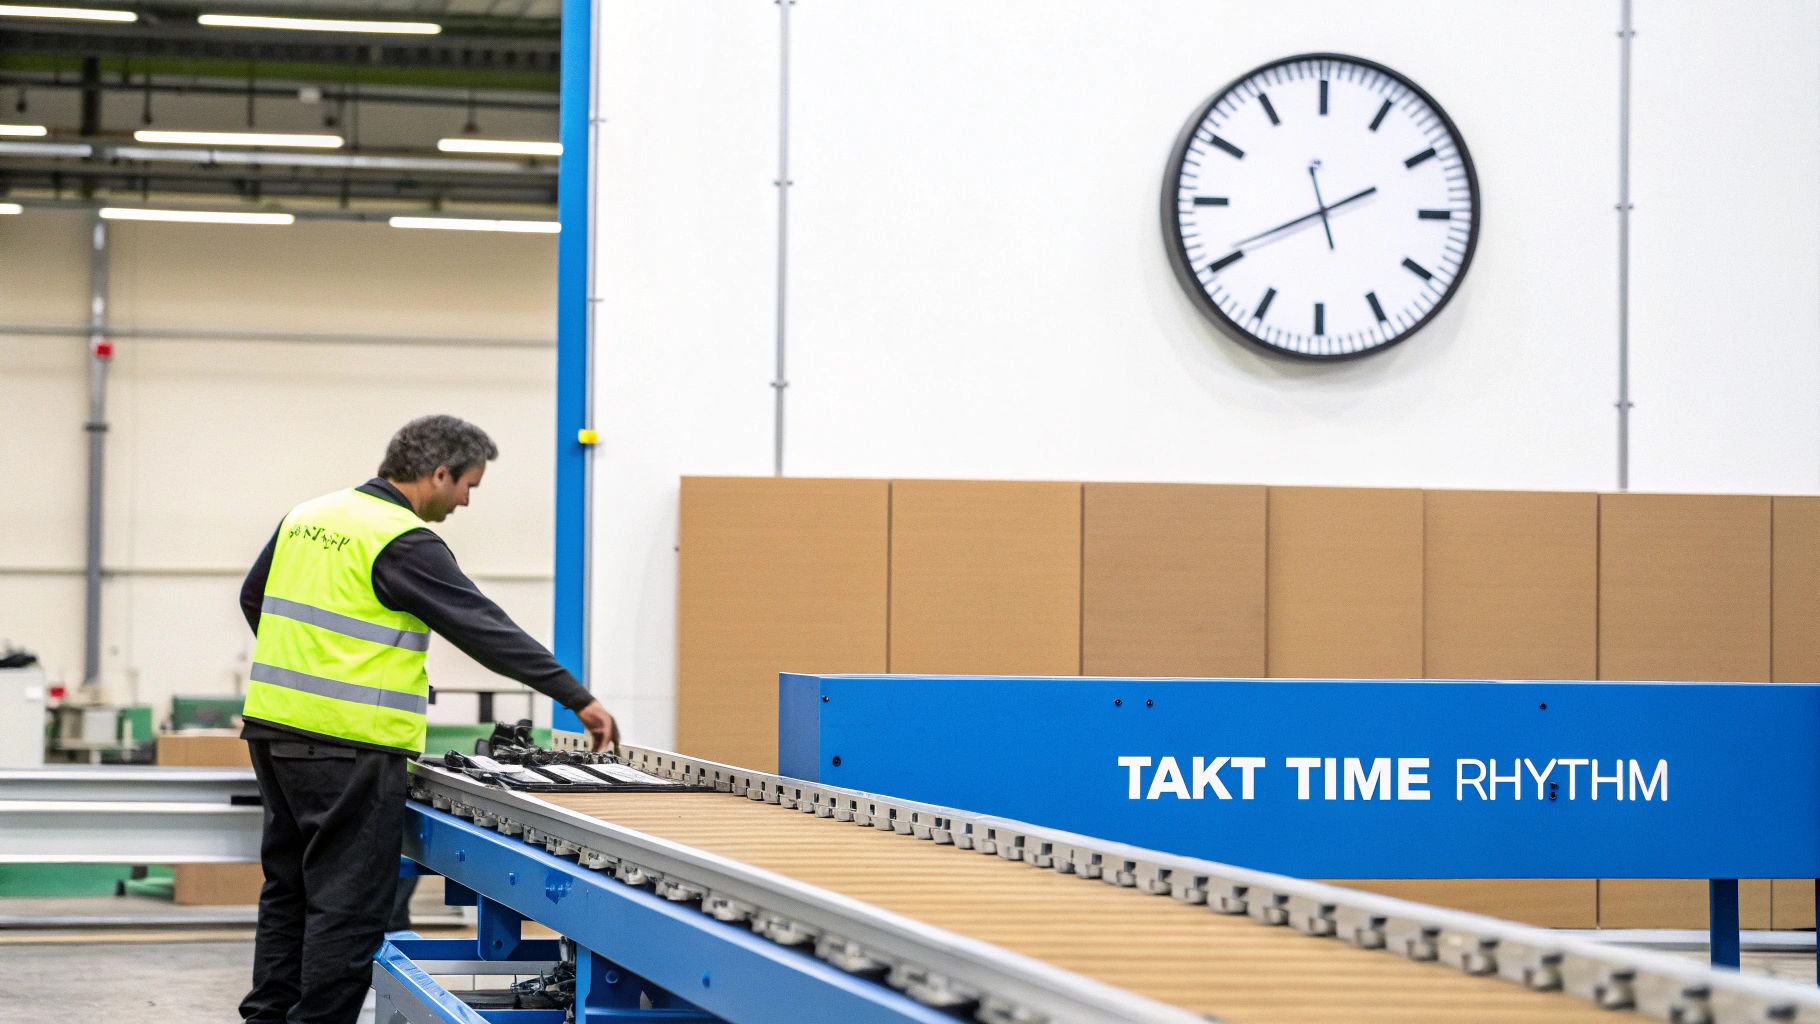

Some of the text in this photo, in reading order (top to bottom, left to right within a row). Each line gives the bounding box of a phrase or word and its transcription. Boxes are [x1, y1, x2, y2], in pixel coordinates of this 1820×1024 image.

[1117, 756, 1668, 802] TAKT TIME RHYTHM
